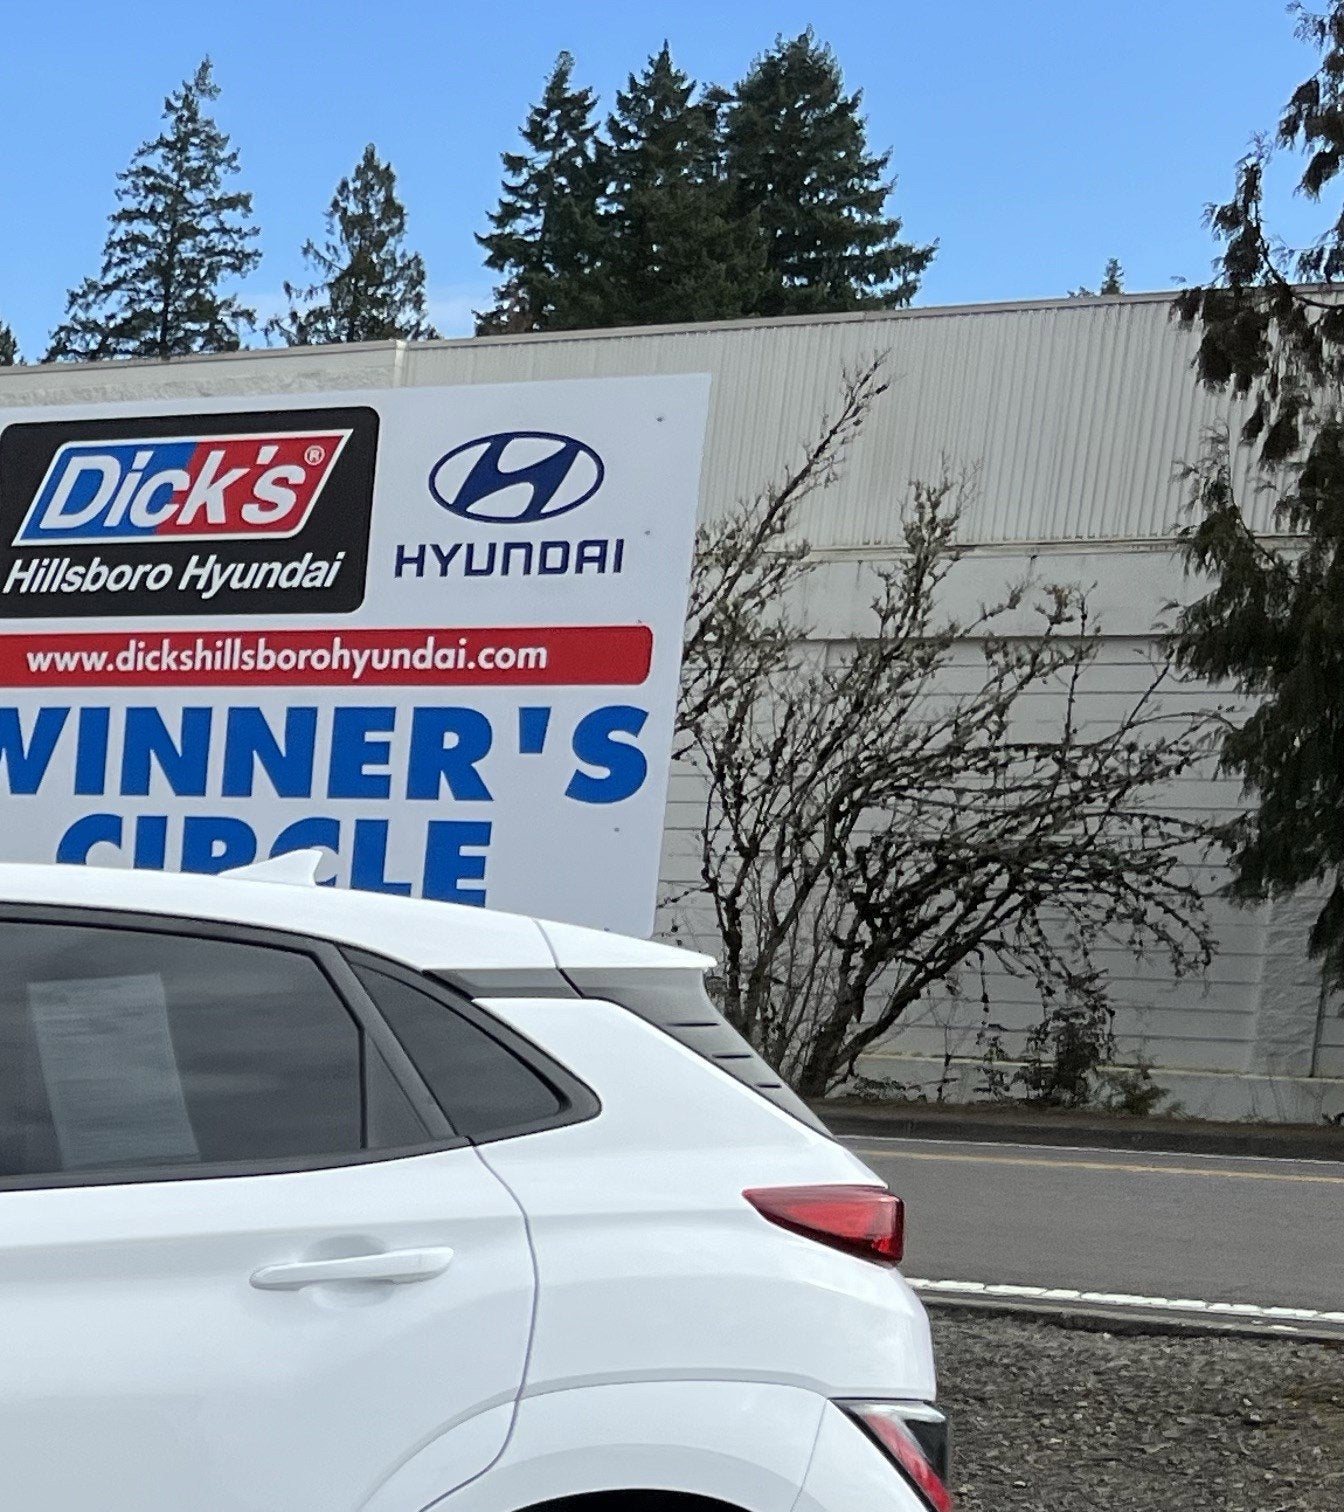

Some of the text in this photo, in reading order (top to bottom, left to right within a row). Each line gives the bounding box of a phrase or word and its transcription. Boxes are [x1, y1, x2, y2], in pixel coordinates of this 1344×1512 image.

[2, 551, 346, 600] Hillsboro Hyundai
[394, 538, 625, 578] HYUNDAI
[26, 636, 547, 681] www.dickshillsborohyundai.com
